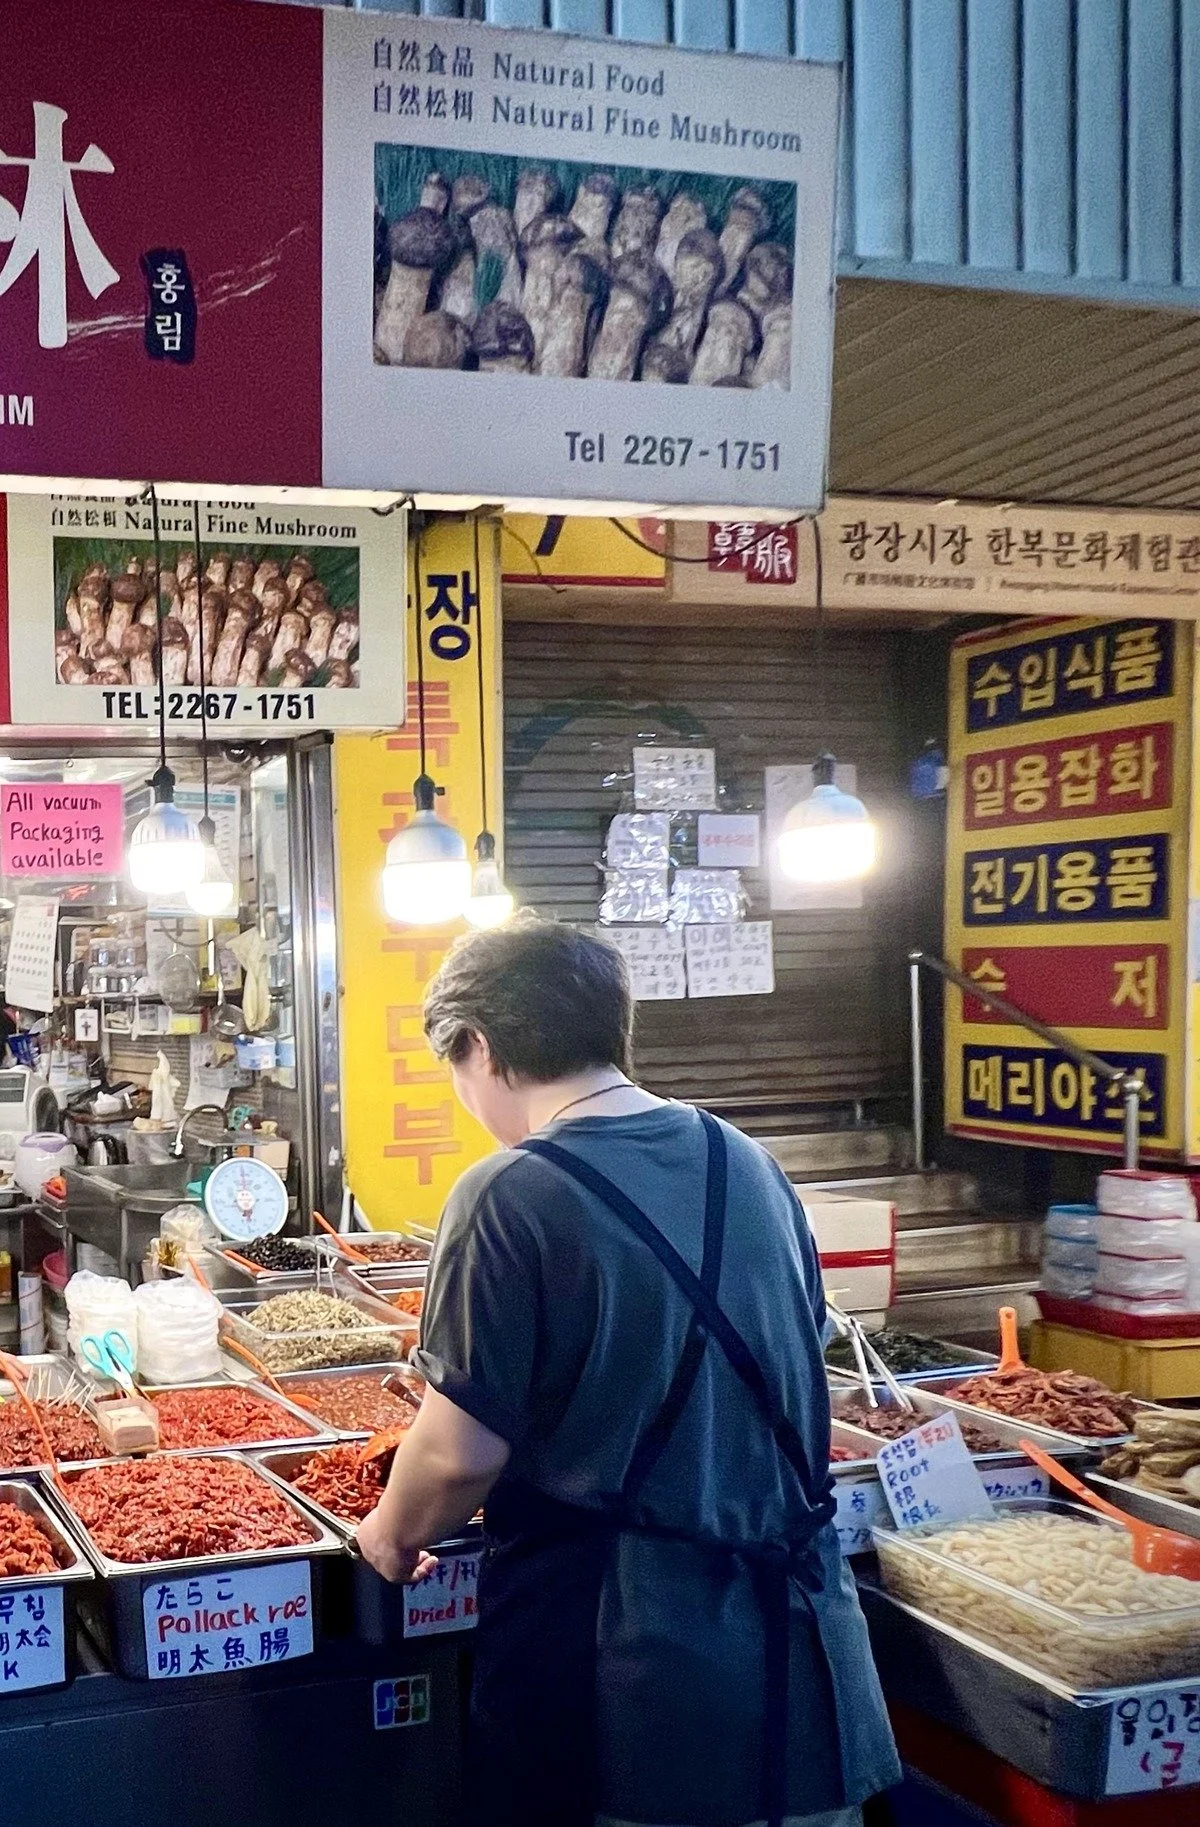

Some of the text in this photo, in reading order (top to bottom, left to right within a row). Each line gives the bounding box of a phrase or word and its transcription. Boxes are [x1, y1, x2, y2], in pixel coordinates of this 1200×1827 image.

[373, 36, 665, 97] 自然食品 Natural Food
[492, 96, 594, 133] Natural
[605, 107, 660, 139] Fine
[670, 114, 801, 153] Mushroom
[154, 264, 186, 351] 홍림
[565, 431, 781, 472] Tel 2267-1751
[125, 510, 198, 532] Naura
[207, 514, 248, 534] Fine
[255, 517, 356, 539] Mushroom
[840, 521, 1200, 573] 광장시장 한복문화체험관
[972, 626, 1163, 718] 수입식품
[971, 735, 1159, 818] 일용잡화
[6, 792, 102, 812] All vacuum
[10, 820, 104, 844] Packaging
[11, 846, 104, 869] available
[969, 846, 1158, 914] 전기용품
[968, 1055, 1157, 1121] 메리야스
[157, 1578, 234, 1610] たらこ
[269, 1595, 307, 1623] roe
[409, 1599, 456, 1626] Dried
[158, 1627, 290, 1676] 明太魚腸
[377, 1692, 425, 1711] JCB
